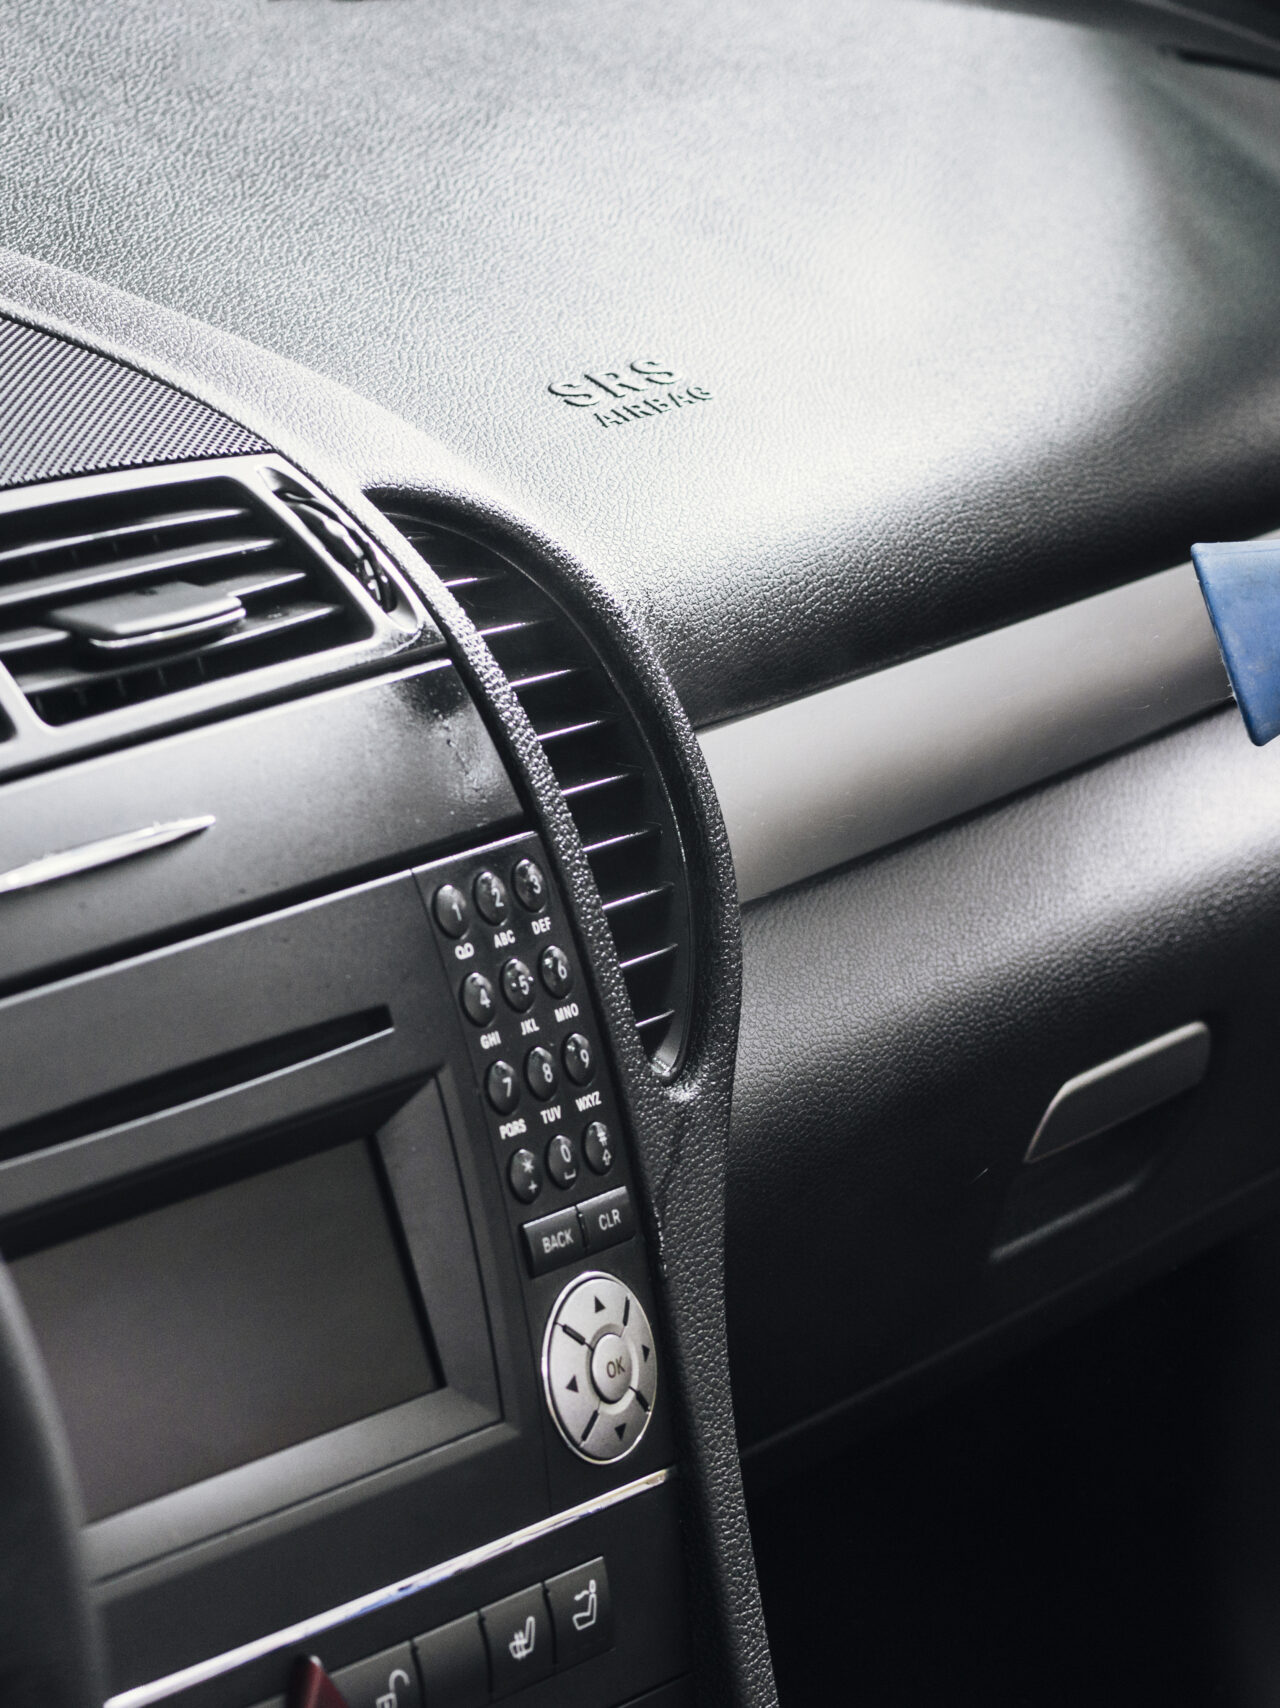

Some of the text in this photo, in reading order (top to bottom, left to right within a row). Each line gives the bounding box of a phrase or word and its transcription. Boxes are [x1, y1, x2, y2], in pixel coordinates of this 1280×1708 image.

[548, 358, 681, 408] SRS
[593, 386, 713, 428] AIRBAG
[529, 874, 542, 894] 3
[491, 887, 504, 907] 2
[452, 902, 462, 921] 1
[531, 916, 552, 935] DEF
[493, 930, 516, 948] ABC
[557, 960, 568, 980] 6
[518, 975, 530, 995] 5
[480, 988, 491, 1008] 4
[554, 1002, 579, 1022] MNO
[520, 1018, 540, 1035] JKL
[480, 1031, 502, 1049] GHI
[580, 1049, 590, 1069] 9
[542, 1063, 553, 1083] 8
[502, 1077, 512, 1098] 7
[575, 1091, 602, 1111] WXYZ
[540, 1105, 562, 1124] TUV
[560, 1144, 571, 1163] 0
[599, 1209, 622, 1231] CLR
[542, 1229, 574, 1253] BACK
[606, 1356, 626, 1379] OK
